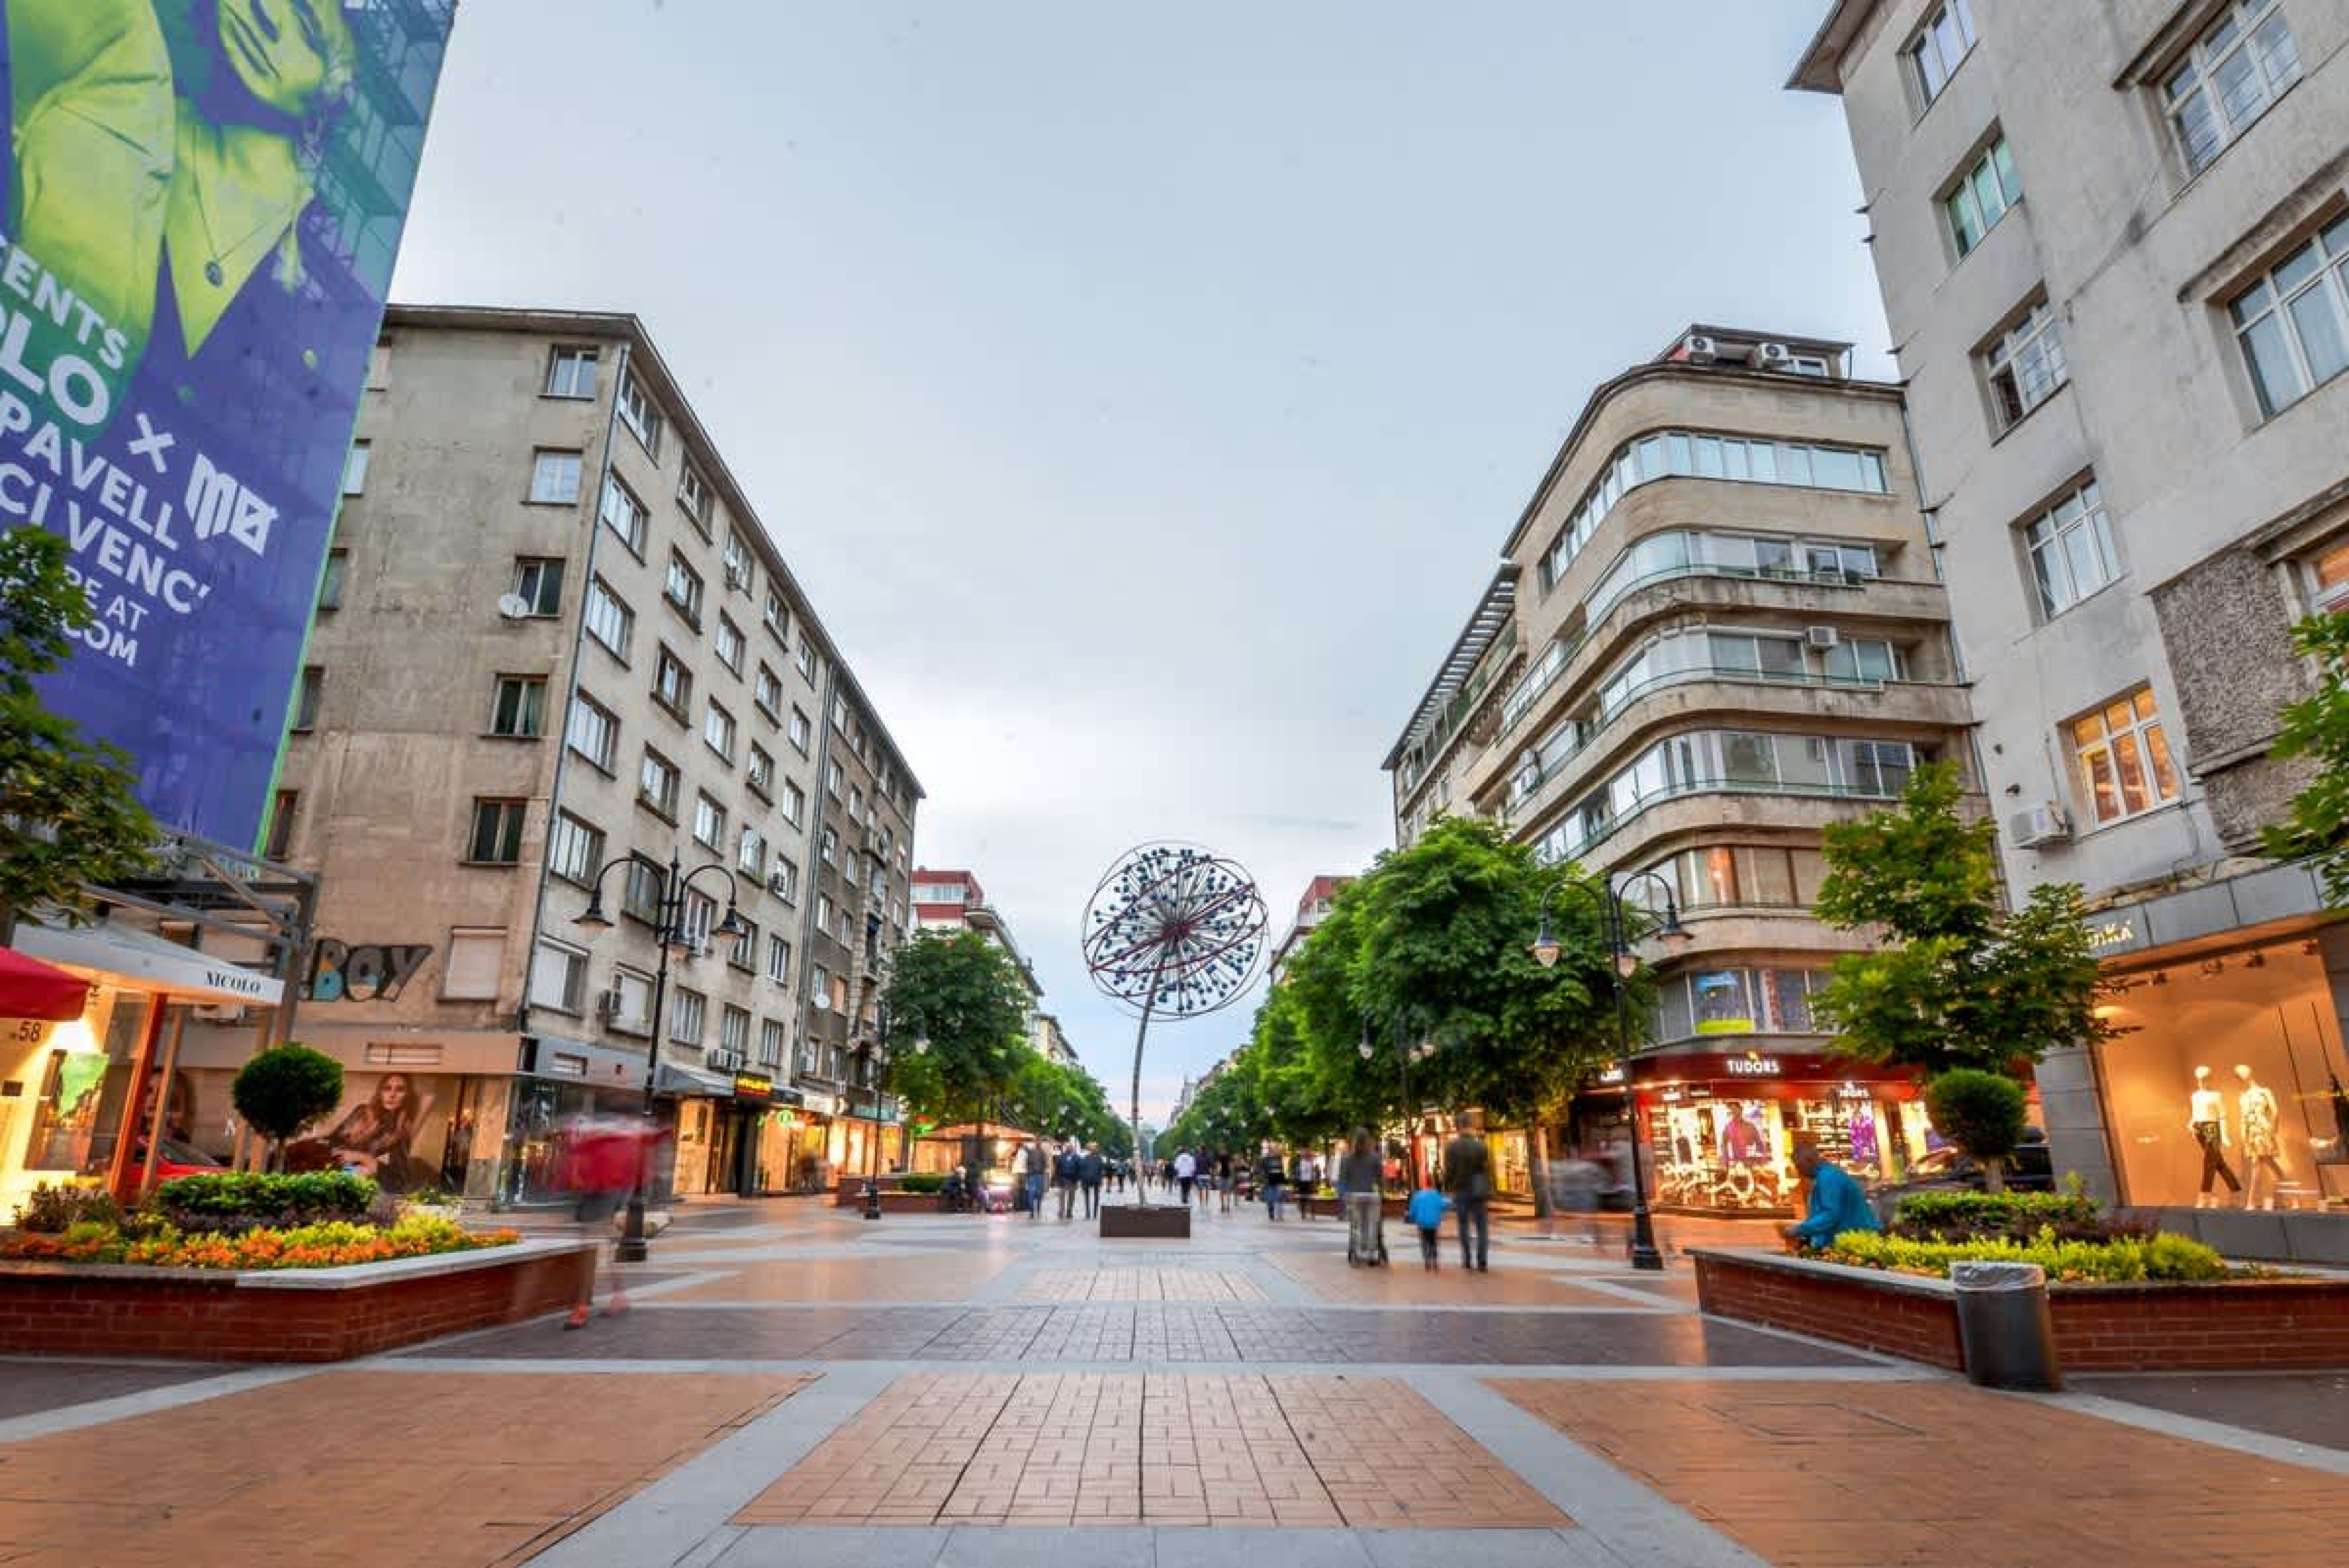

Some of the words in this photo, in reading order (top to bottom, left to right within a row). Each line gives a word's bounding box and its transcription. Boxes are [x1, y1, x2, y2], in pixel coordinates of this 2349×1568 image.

[0, 239, 128, 370] ENTS
[0, 309, 110, 425] LO
[105, 595, 149, 631] AT
